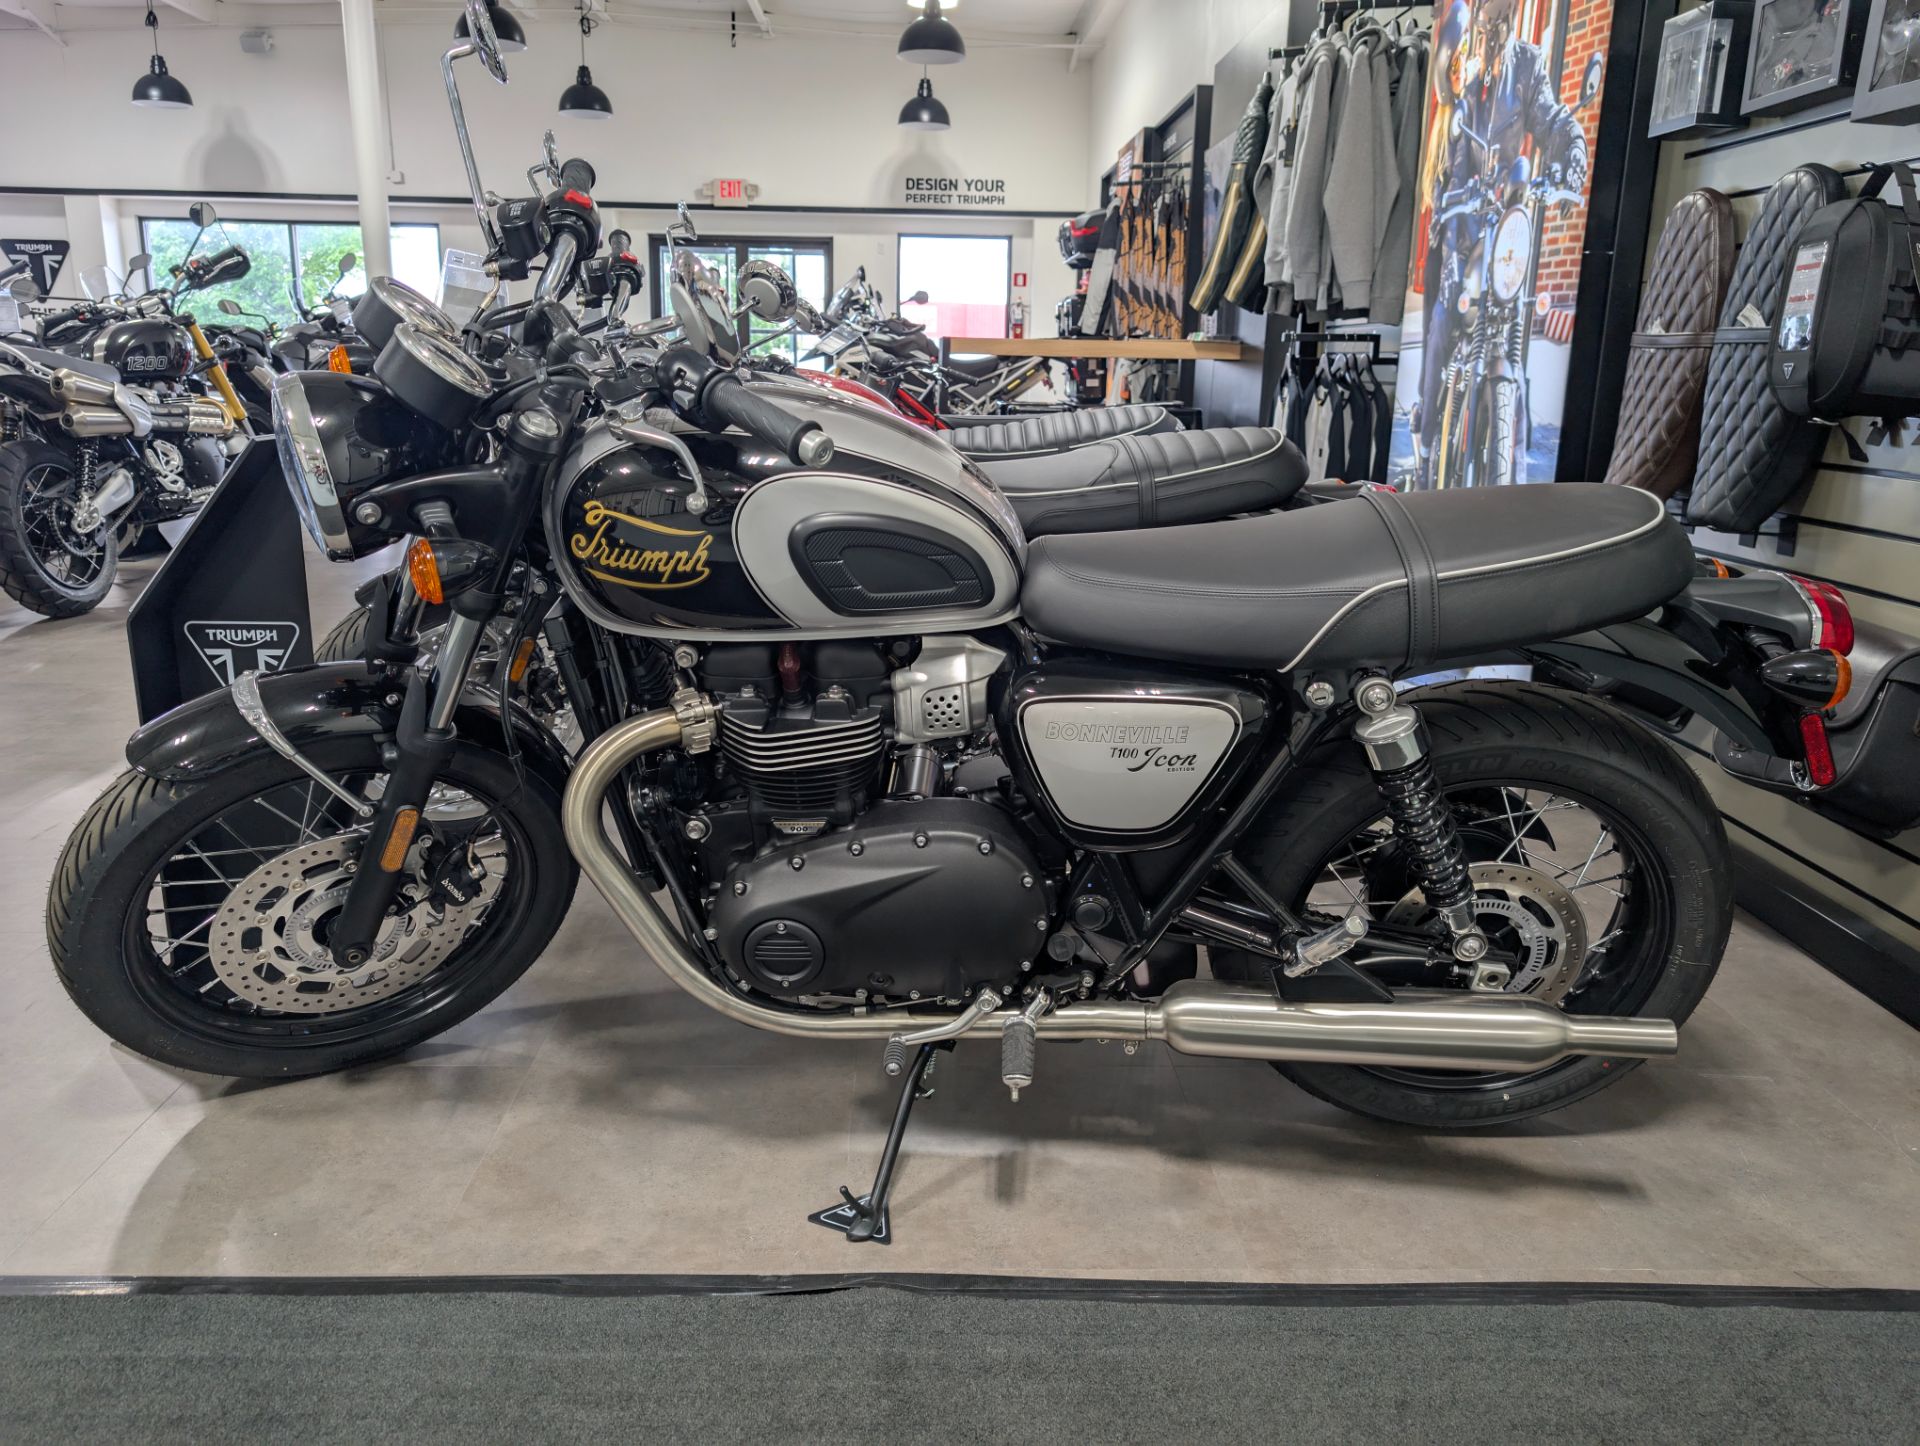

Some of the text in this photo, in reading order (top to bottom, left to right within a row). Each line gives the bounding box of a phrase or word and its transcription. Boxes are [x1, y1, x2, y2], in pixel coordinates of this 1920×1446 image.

[719, 179, 742, 199] EXIT
[905, 177, 1005, 193] DESIGN YOUR
[905, 193, 1005, 206] PERFECT TRIUMPH
[14, 243, 53, 254] TRIUMPH
[127, 355, 168, 371] 1200
[571, 500, 714, 589] Triumph
[205, 629, 278, 646] TRIUMPH
[1045, 721, 1190, 745] BONNEVILLE
[1110, 746, 1197, 773] T100 Icon
[440, 877, 466, 902] brembo
